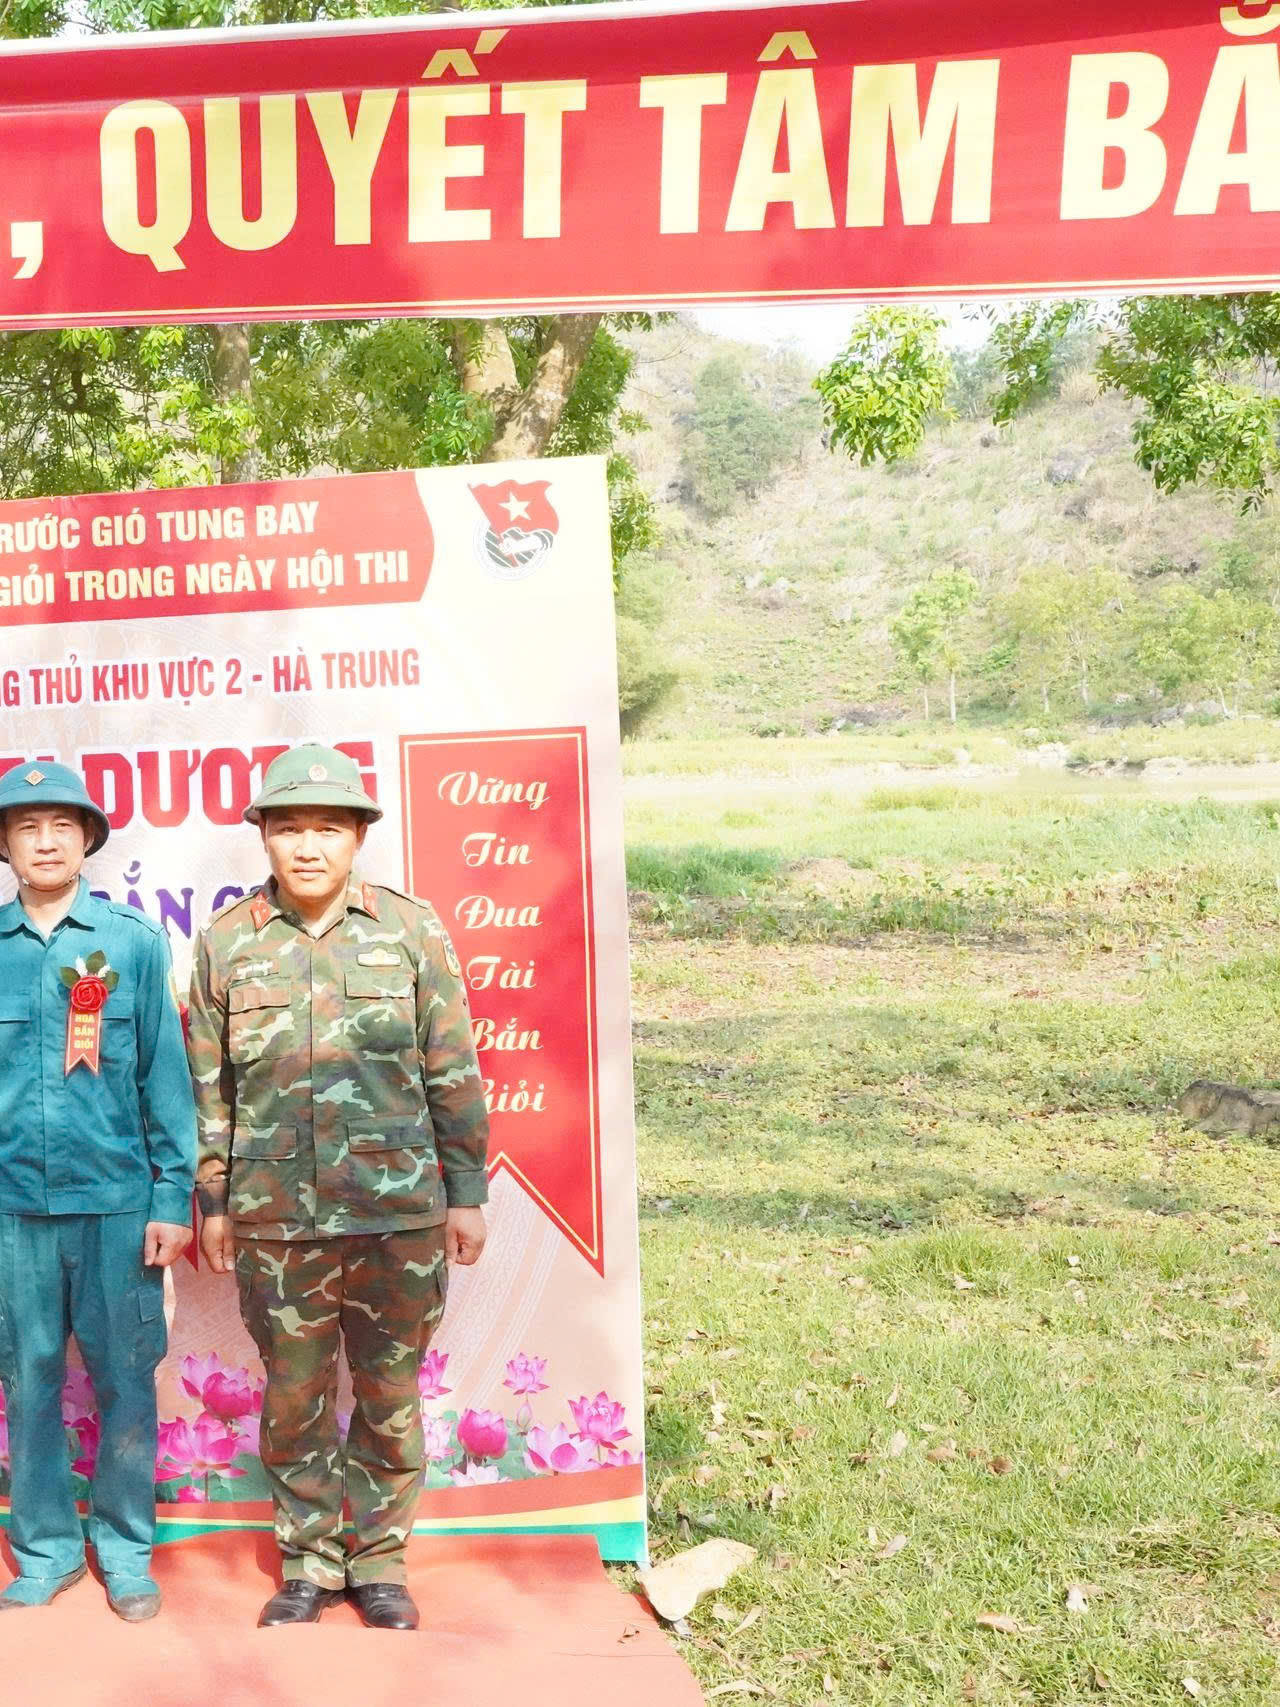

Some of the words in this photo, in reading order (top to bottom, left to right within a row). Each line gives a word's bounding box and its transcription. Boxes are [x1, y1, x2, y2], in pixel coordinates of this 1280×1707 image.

[100, 29, 588, 273] QUYẾT
[639, 31, 1001, 235] TÂM
[91, 508, 147, 548] GIÓ
[156, 506, 246, 542] TUNG
[255, 501, 319, 537] BAY
[64, 566, 175, 602] TRONG
[184, 552, 277, 595] NGÀY
[287, 551, 345, 595] HỘI
[354, 550, 409, 585] THI
[28, 654, 82, 706] THỦ
[93, 663, 149, 703] KHU
[158, 657, 215, 706] VỰC
[225, 659, 243, 694] 2
[272, 649, 313, 693] HÀ
[320, 648, 420, 689] TRUNG
[81, 740, 377, 830] DƯƠ
[438, 771, 550, 810] Vững
[462, 832, 533, 867] Tin
[454, 895, 543, 929] Đua
[466, 955, 536, 991] Tài
[471, 1017, 544, 1052] Bắn
